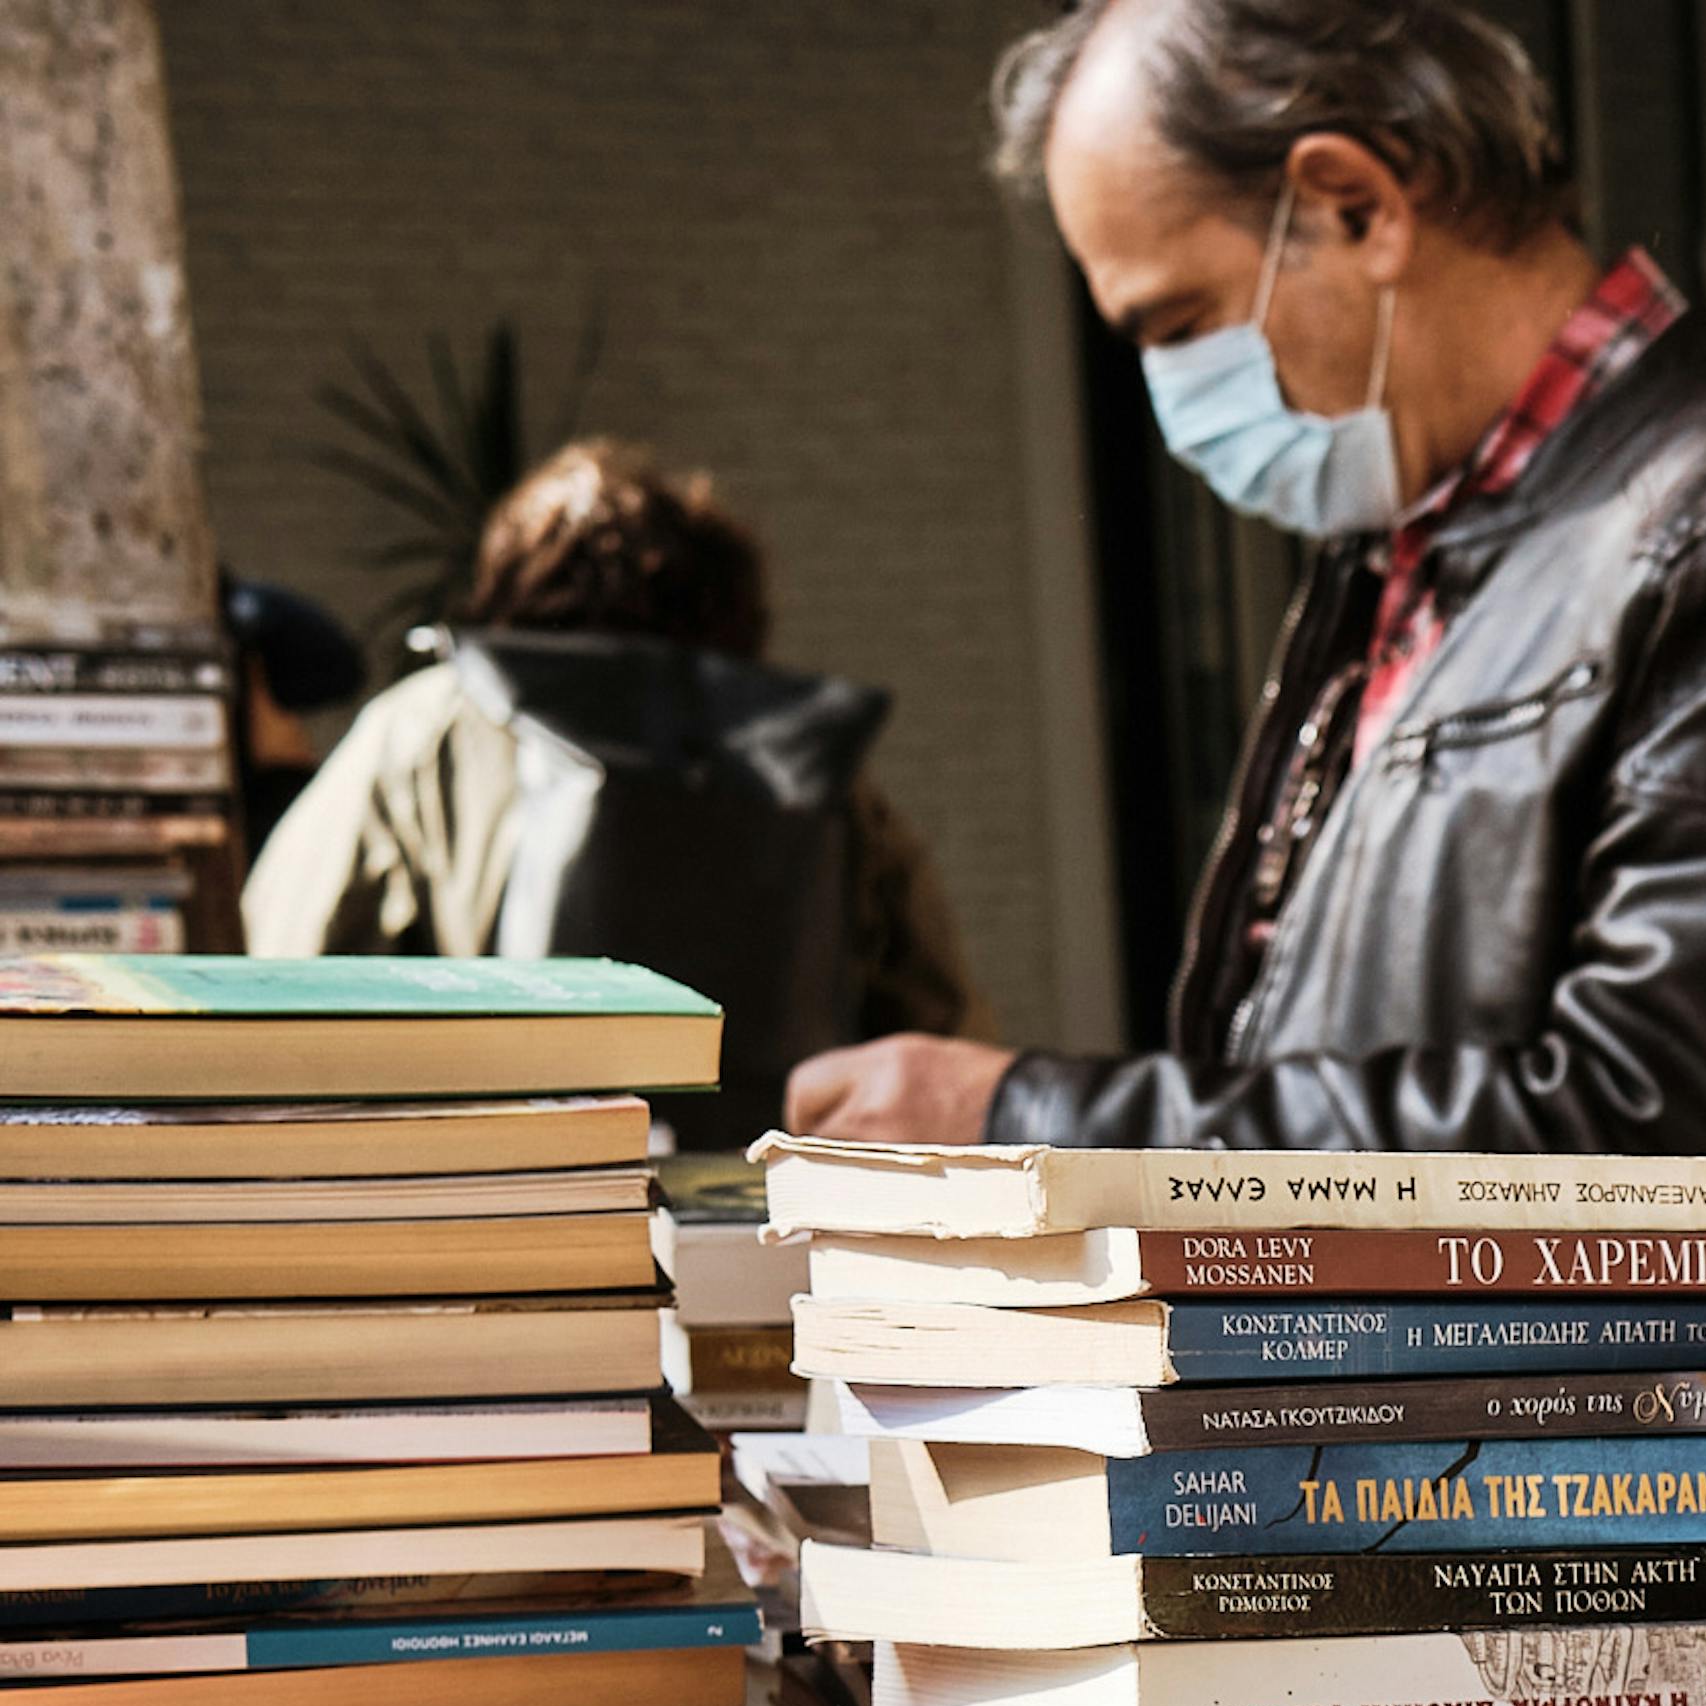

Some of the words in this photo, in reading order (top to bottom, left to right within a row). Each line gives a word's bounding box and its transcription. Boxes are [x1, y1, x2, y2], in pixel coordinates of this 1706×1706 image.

[1287, 1177, 1376, 1201] ΜΑΜΑ
[1397, 1177, 1416, 1201] Η
[1458, 1180, 1562, 1205] ΔΗΜΑΣΟΣ
[1183, 1237, 1246, 1259] DORA
[1257, 1237, 1313, 1259] LEVY
[1438, 1237, 1504, 1285] ΤΟ
[1185, 1264, 1315, 1286] MOSSANEN
[1222, 1312, 1387, 1335] ΚΩΝΣΤΑΝΤΙΝΟΣ
[1407, 1327, 1422, 1347] Η
[1433, 1321, 1590, 1347] ΜΕΓΑΛΕΙΩΔΗΣ
[1599, 1320, 1675, 1343] ΑΠΑΤΗ
[1262, 1340, 1348, 1362] ΚΟΛΜΕΡ
[1202, 1409, 1279, 1431] ΝΑΤΑΣΑ
[1280, 1403, 1405, 1428] ΓΚΟΥΤΖΙΚΙΔΟΥ
[1507, 1391, 1577, 1425] χορός
[1587, 1395, 1623, 1418] της
[1173, 1471, 1247, 1496] SAHAR
[1299, 1479, 1344, 1524] ΤΑ
[1356, 1477, 1474, 1523] ΠΑΙΔΙΑ
[1484, 1474, 1547, 1519] ΤΗΣ
[1166, 1503, 1257, 1533] DELIJANI
[1192, 1572, 1335, 1591] ΚΩΝΣΤΑΝΤΙΝΟΣ
[1434, 1563, 1542, 1589] ΝΑΥΑΓΙΑ
[1553, 1562, 1621, 1587] ΣΤΗΝ
[1630, 1559, 1697, 1586] ΑΚΤΗ
[1489, 1589, 1544, 1615] ΤΩΝ
[1554, 1586, 1646, 1613] ΠΟΘΩΝ
